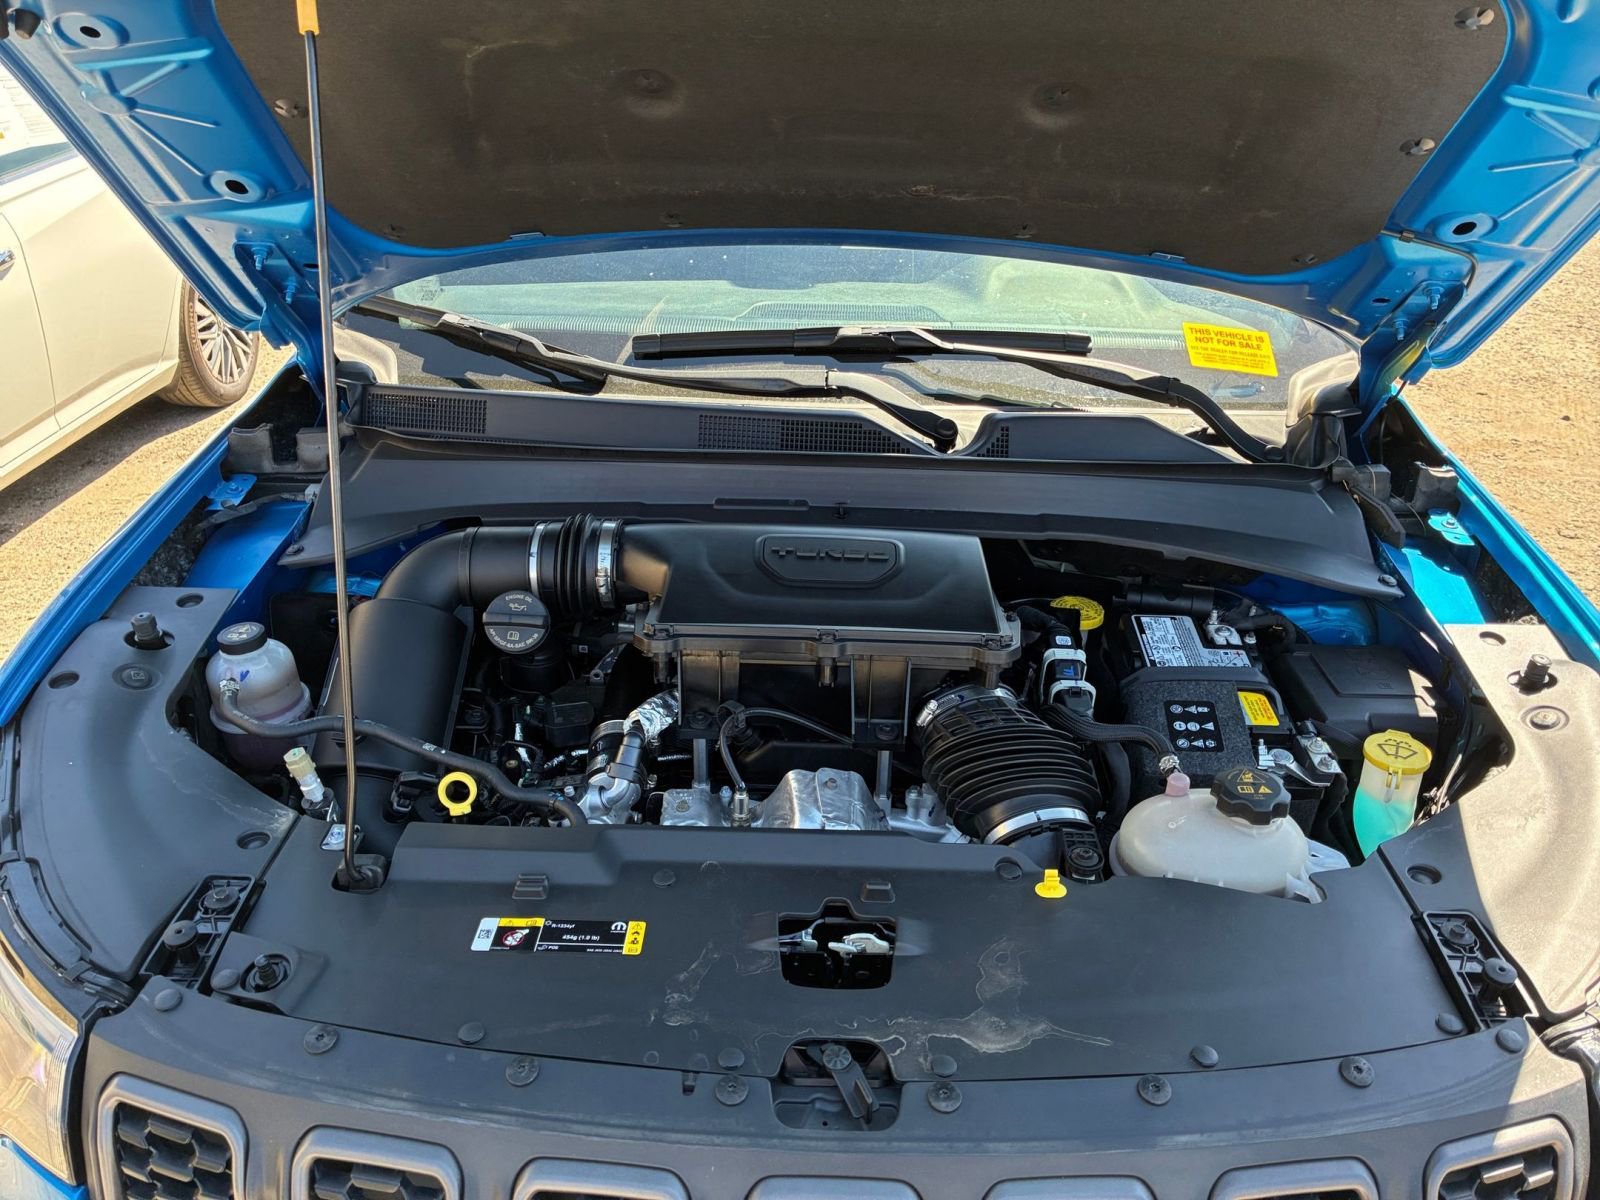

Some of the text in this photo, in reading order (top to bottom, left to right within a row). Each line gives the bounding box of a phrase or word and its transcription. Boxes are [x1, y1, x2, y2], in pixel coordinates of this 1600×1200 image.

[1189, 327, 1265, 343] THIS VEHICLE IS
[1195, 336, 1264, 351] NOT FOR SALE
[525, 595, 533, 603] OIL
